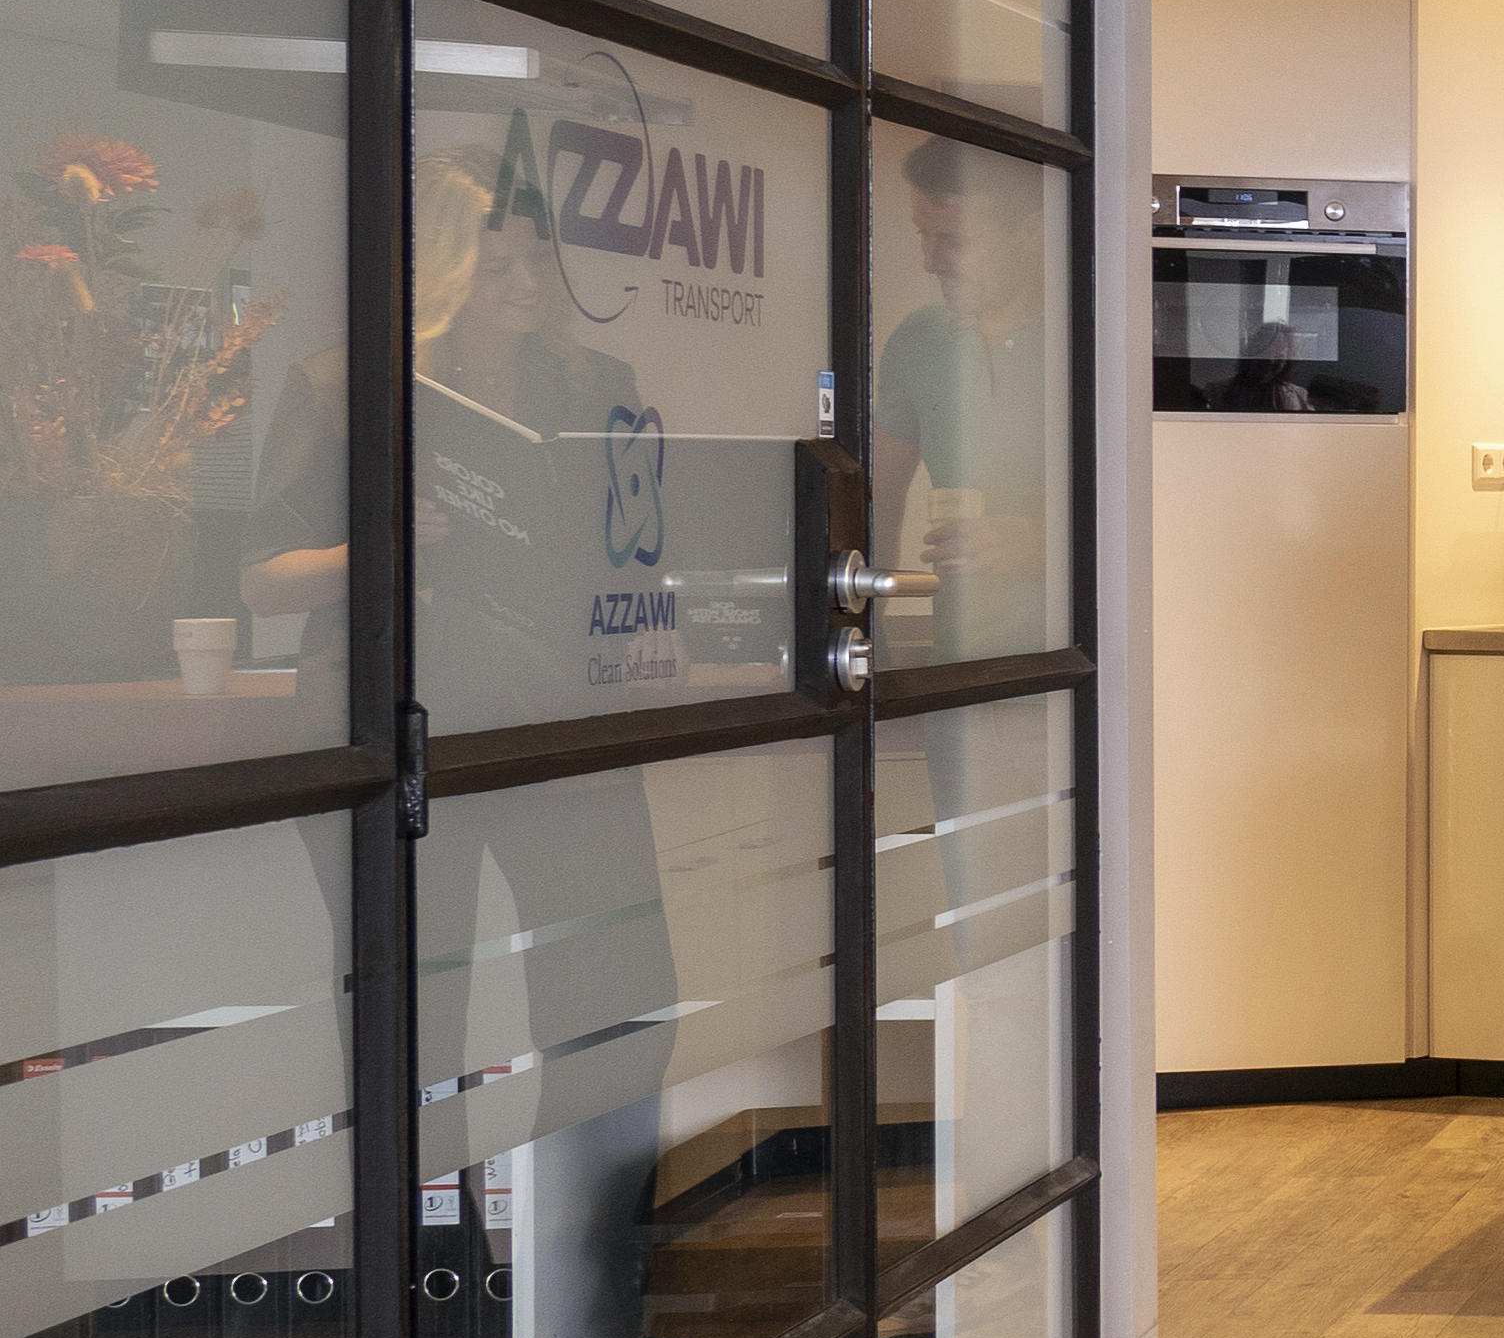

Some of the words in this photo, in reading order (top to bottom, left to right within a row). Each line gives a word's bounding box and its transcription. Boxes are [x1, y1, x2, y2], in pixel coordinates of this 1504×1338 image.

[487, 107, 764, 278] AZZAWI
[661, 279, 764, 326] TRANSPORT
[589, 591, 675, 636] AZZAWI
[588, 654, 622, 686] Clean
[626, 650, 677, 683] Solutions
